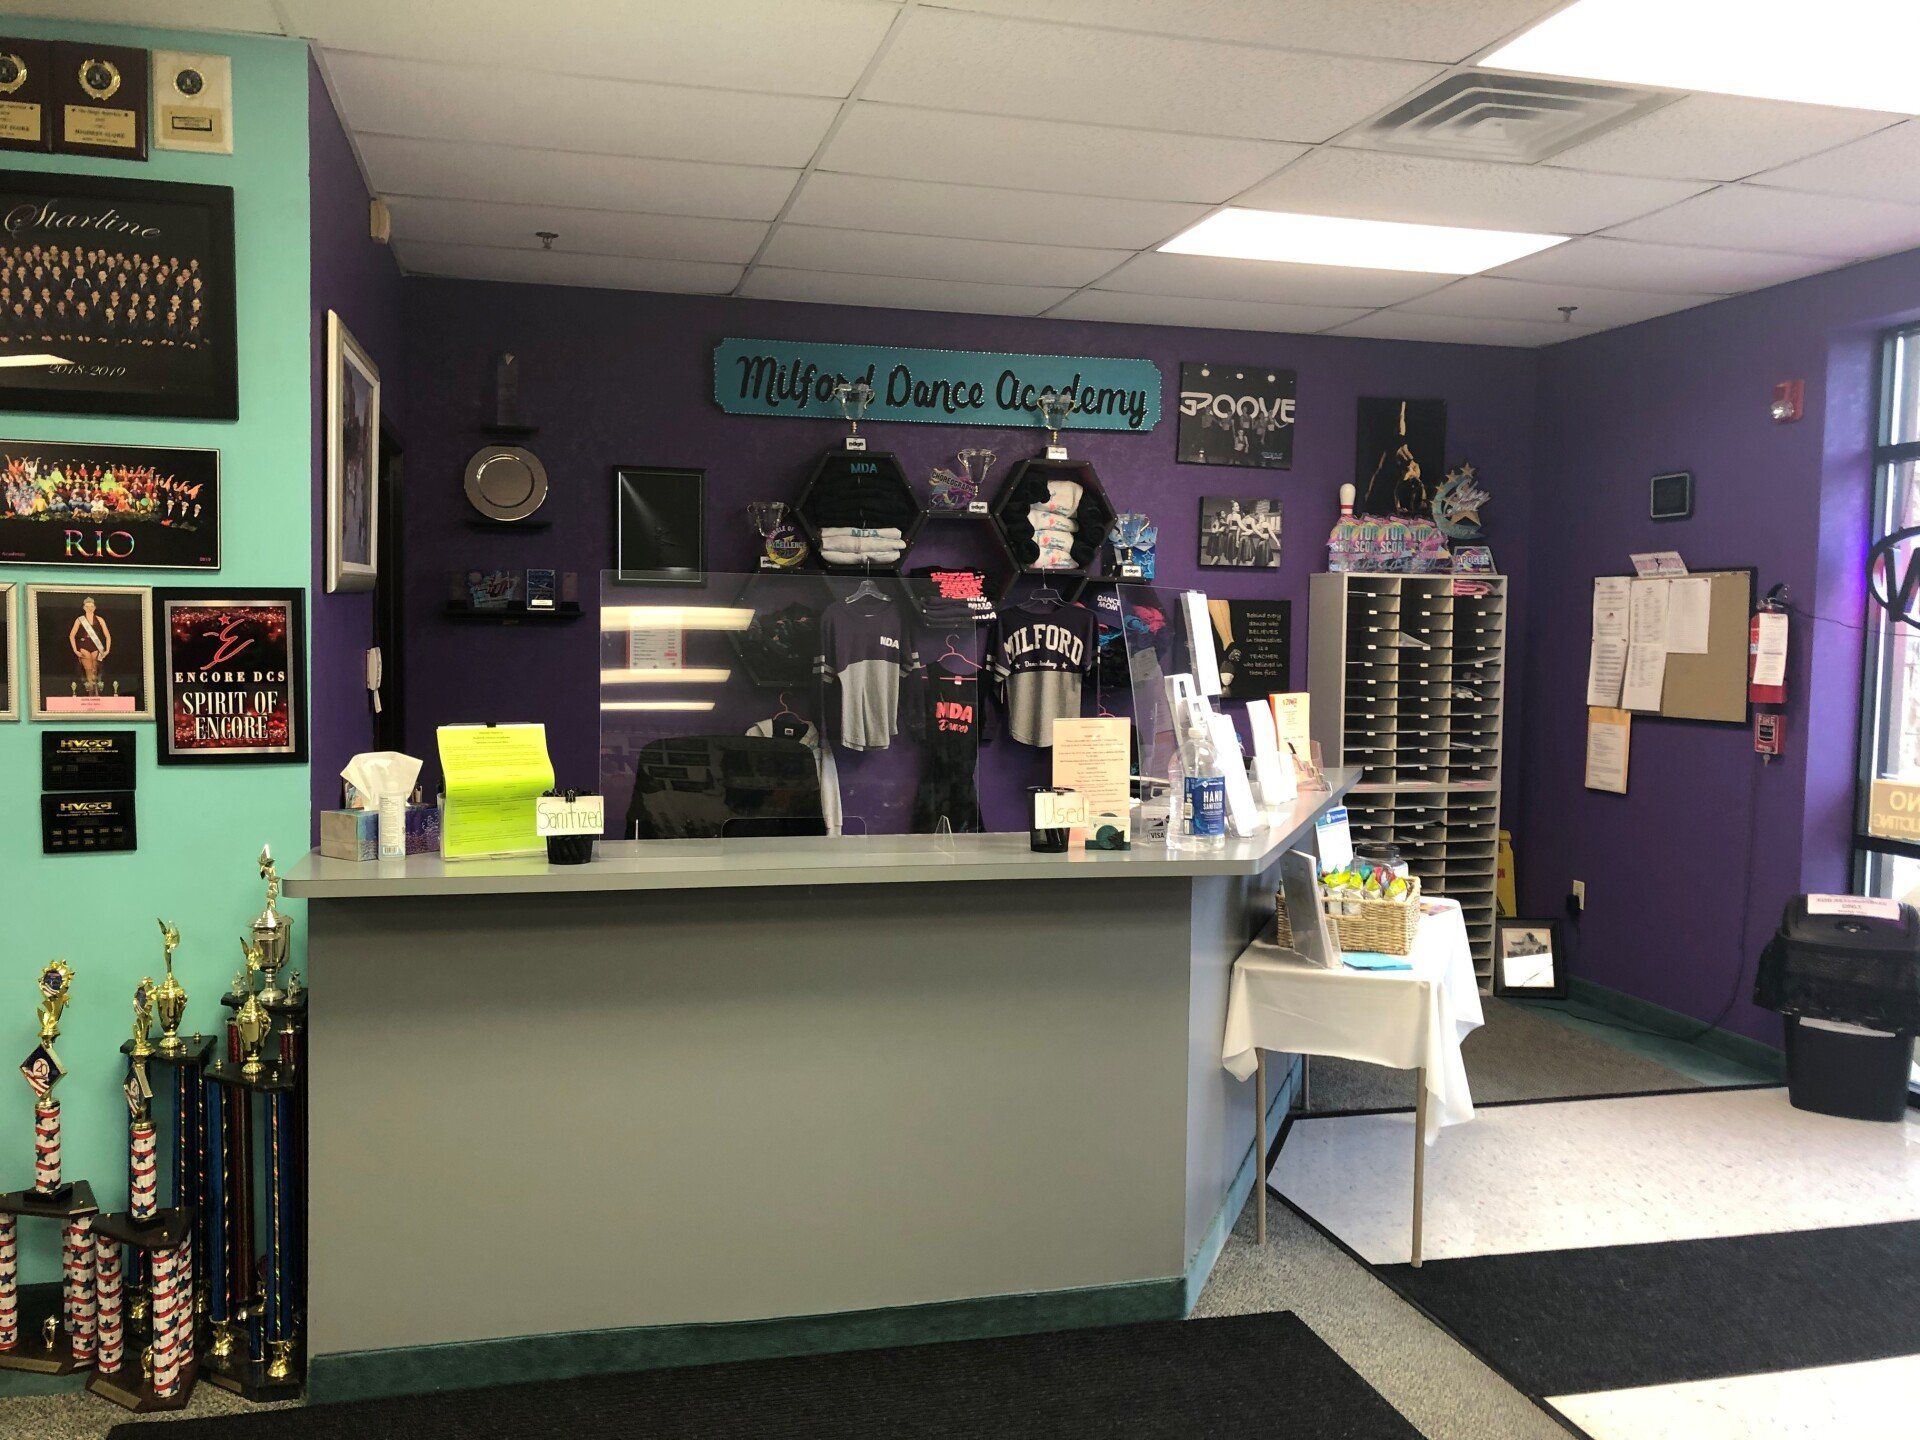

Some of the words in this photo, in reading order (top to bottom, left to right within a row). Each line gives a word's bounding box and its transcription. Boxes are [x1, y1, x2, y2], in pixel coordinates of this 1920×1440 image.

[4, 200, 161, 238] Starline
[48, 364, 127, 378] 2018-2019
[736, 355, 876, 409] Milford
[885, 364, 985, 415] Dance
[850, 462, 878, 474] MDA
[63, 529, 136, 559] RIO
[1096, 595, 1120, 606] DANCE
[1097, 602, 1119, 611] MOM
[1003, 624, 1084, 666] MILFORD
[174, 671, 246, 683] ENCORE
[253, 671, 286, 682] DCS
[182, 691, 248, 715] SPIRIT
[254, 691, 279, 716] OF
[935, 701, 973, 724] MDA
[195, 716, 270, 740] ENCORE
[1203, 790, 1223, 803] HAND
[537, 802, 603, 830] Sanitized
[1043, 796, 1086, 825] Used
